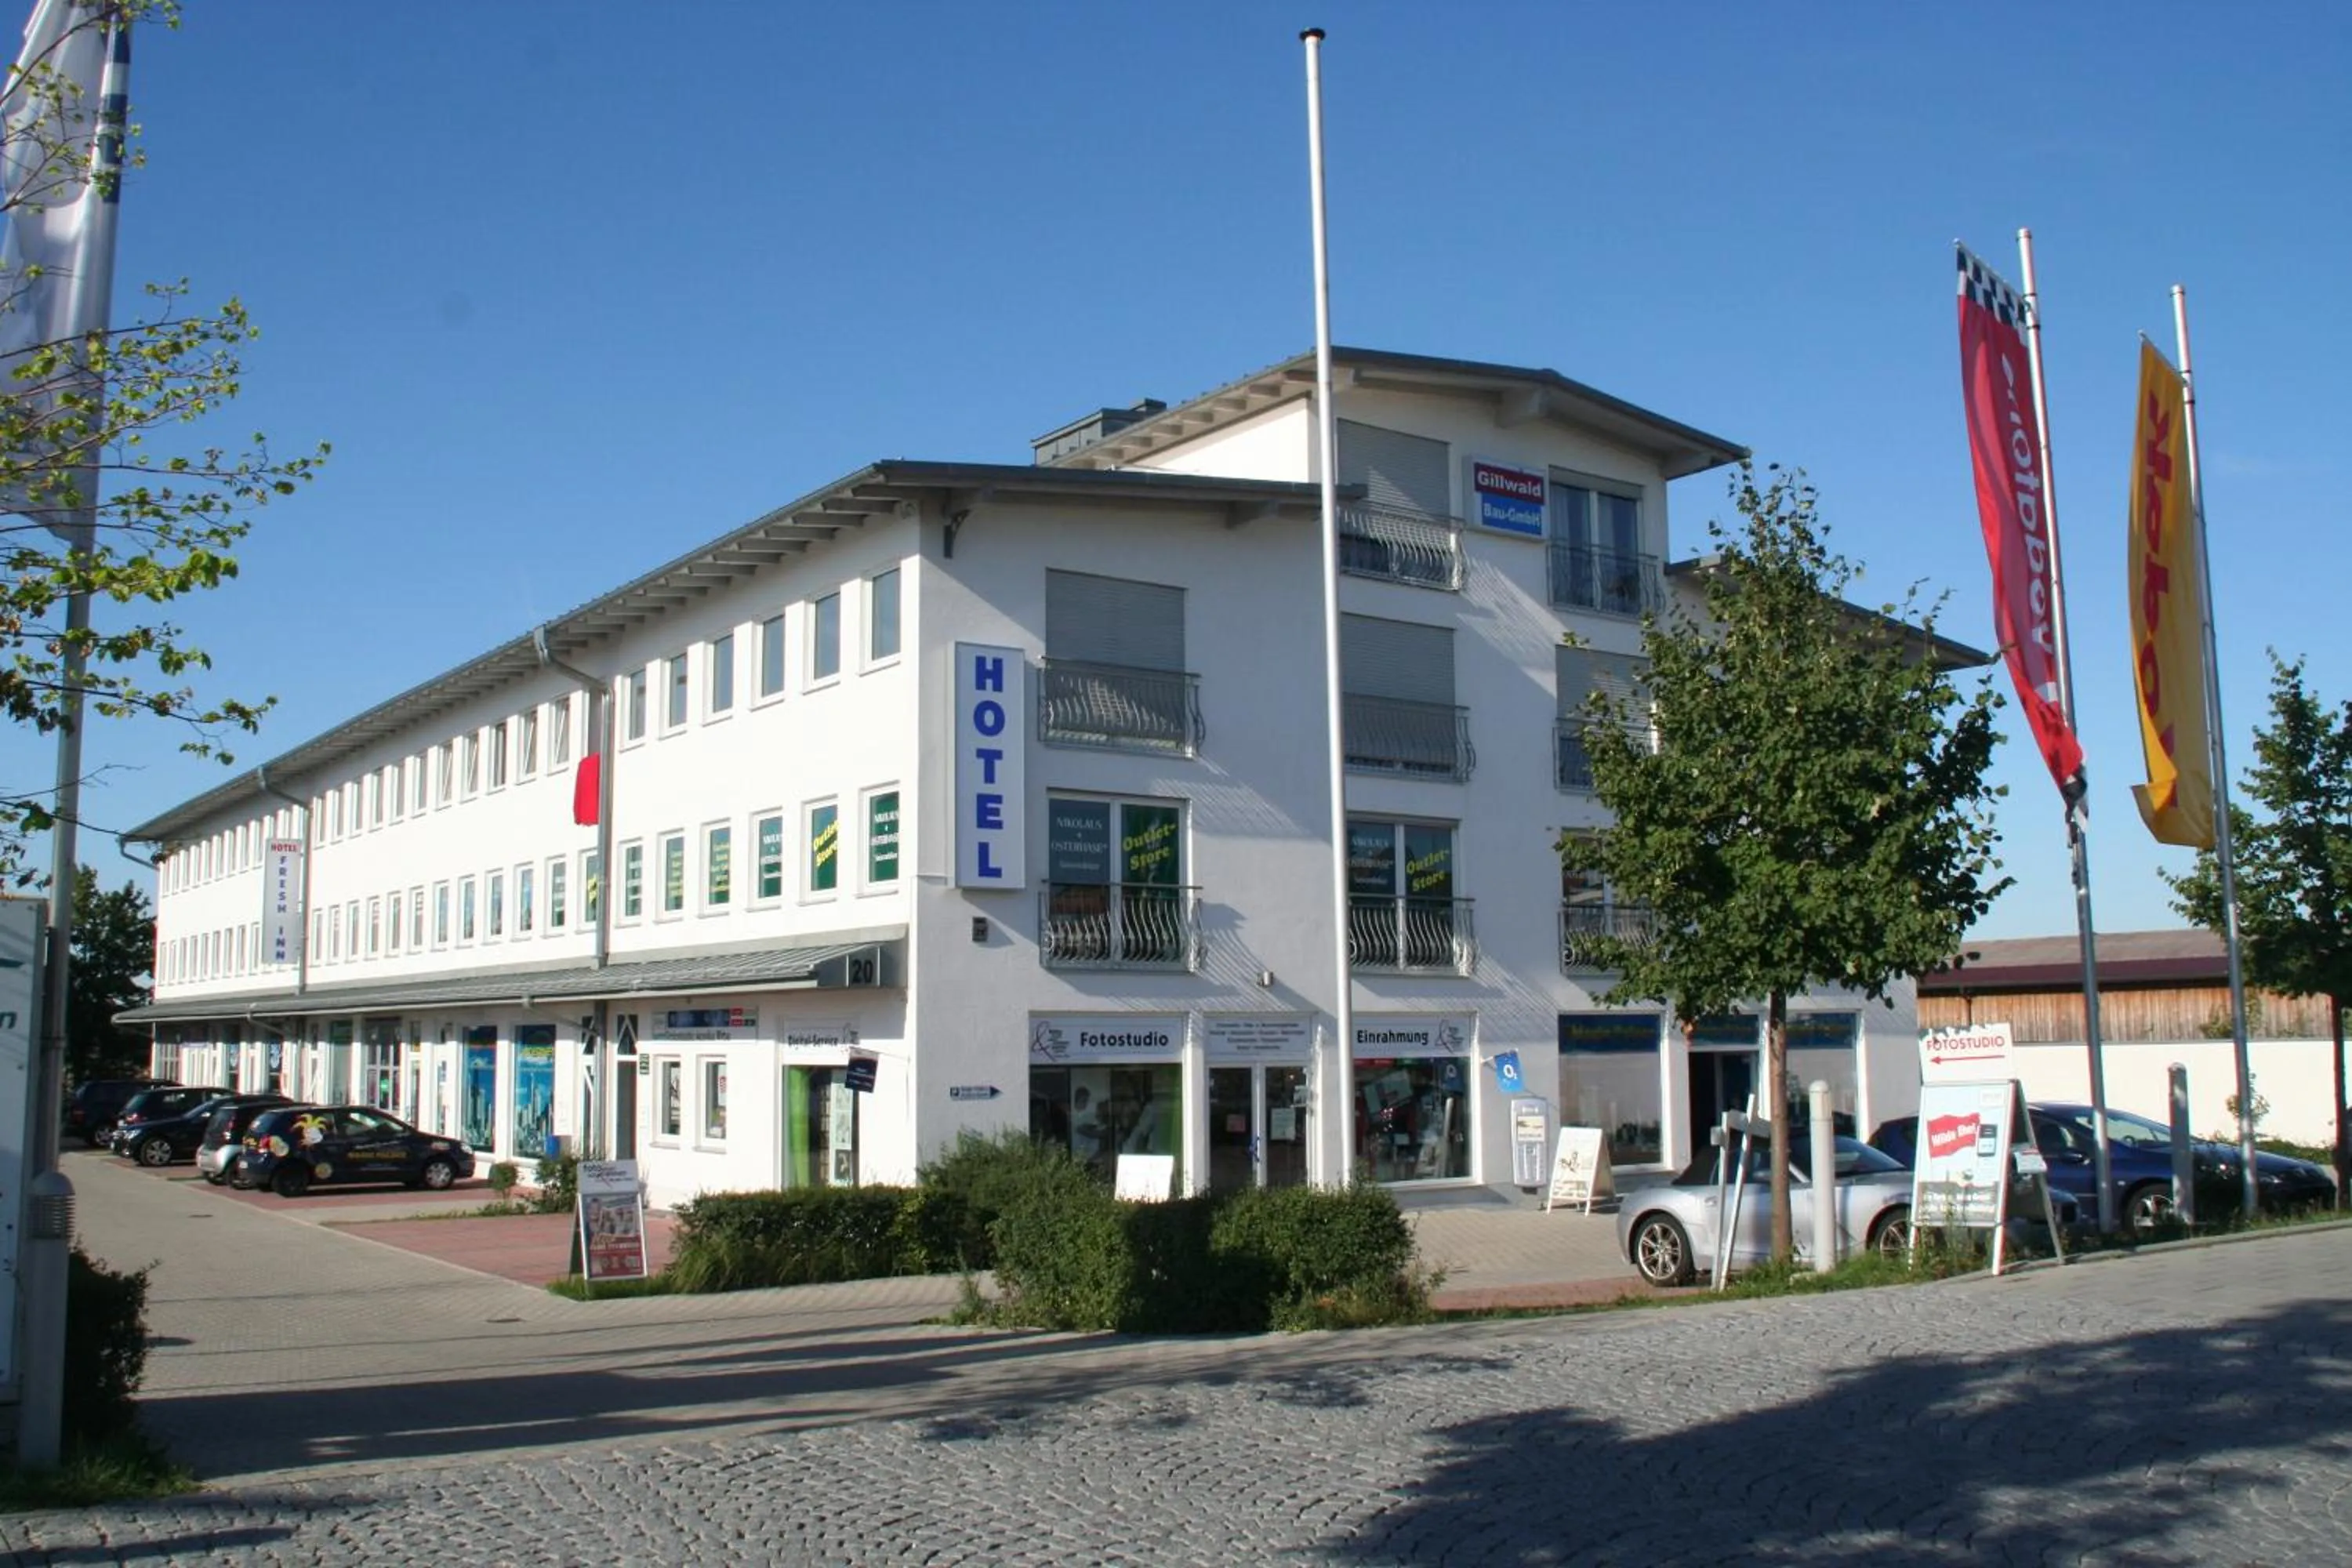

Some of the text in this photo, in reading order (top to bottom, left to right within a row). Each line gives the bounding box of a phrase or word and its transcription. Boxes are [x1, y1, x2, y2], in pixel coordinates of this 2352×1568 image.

[1477, 470, 1542, 498] Gillwald
[1483, 503, 1541, 528] Bau-GmbH
[974, 655, 1006, 879] HOTEL
[271, 844, 297, 852] HOTEL
[1130, 847, 1170, 870] Store
[275, 855, 287, 960] FRESH INN
[851, 959, 873, 984] 20
[1080, 1031, 1169, 1047] Fotostudio
[1356, 1029, 1429, 1046] Einrahmung
[1926, 1036, 2005, 1051] FOTOSTUDIO
